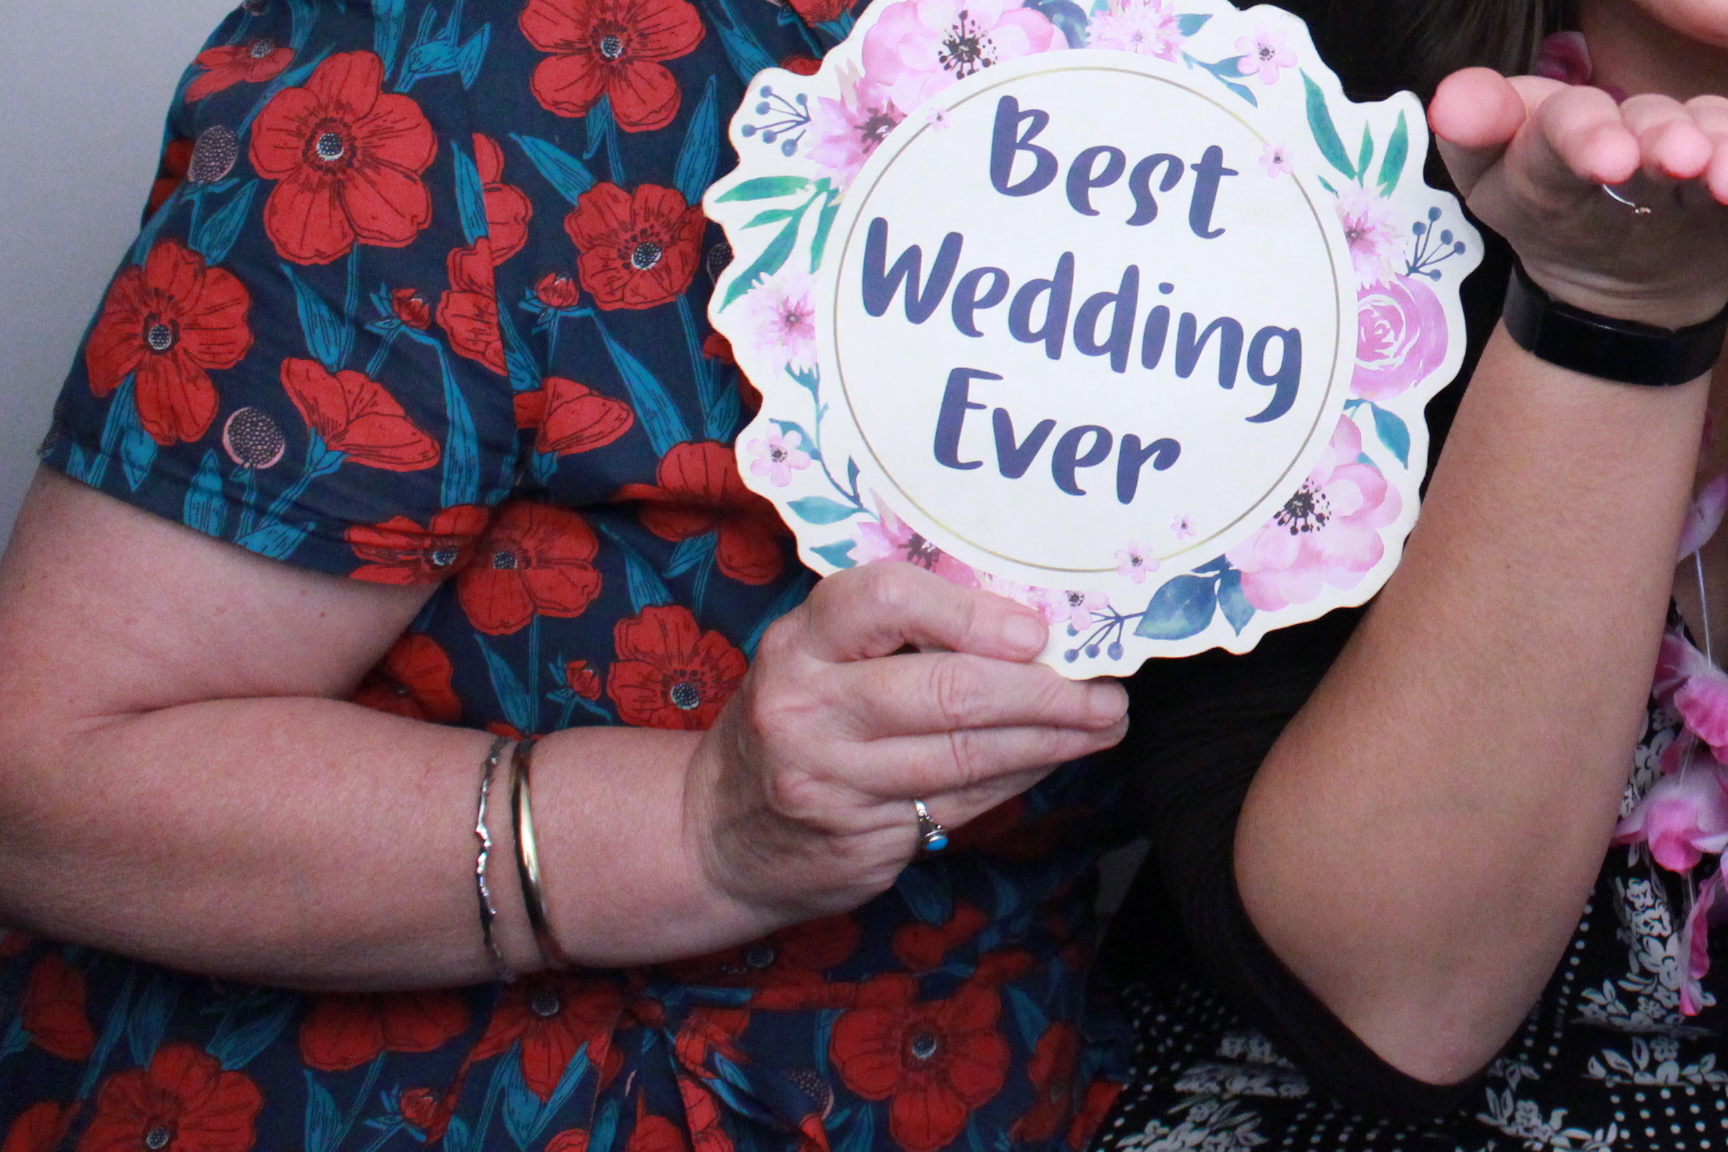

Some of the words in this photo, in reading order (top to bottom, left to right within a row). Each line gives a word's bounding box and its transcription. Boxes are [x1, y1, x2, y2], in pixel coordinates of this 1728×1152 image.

[988, 94, 1240, 240] Best
[860, 216, 1303, 423] Wedding
[932, 366, 1182, 506] Ever
